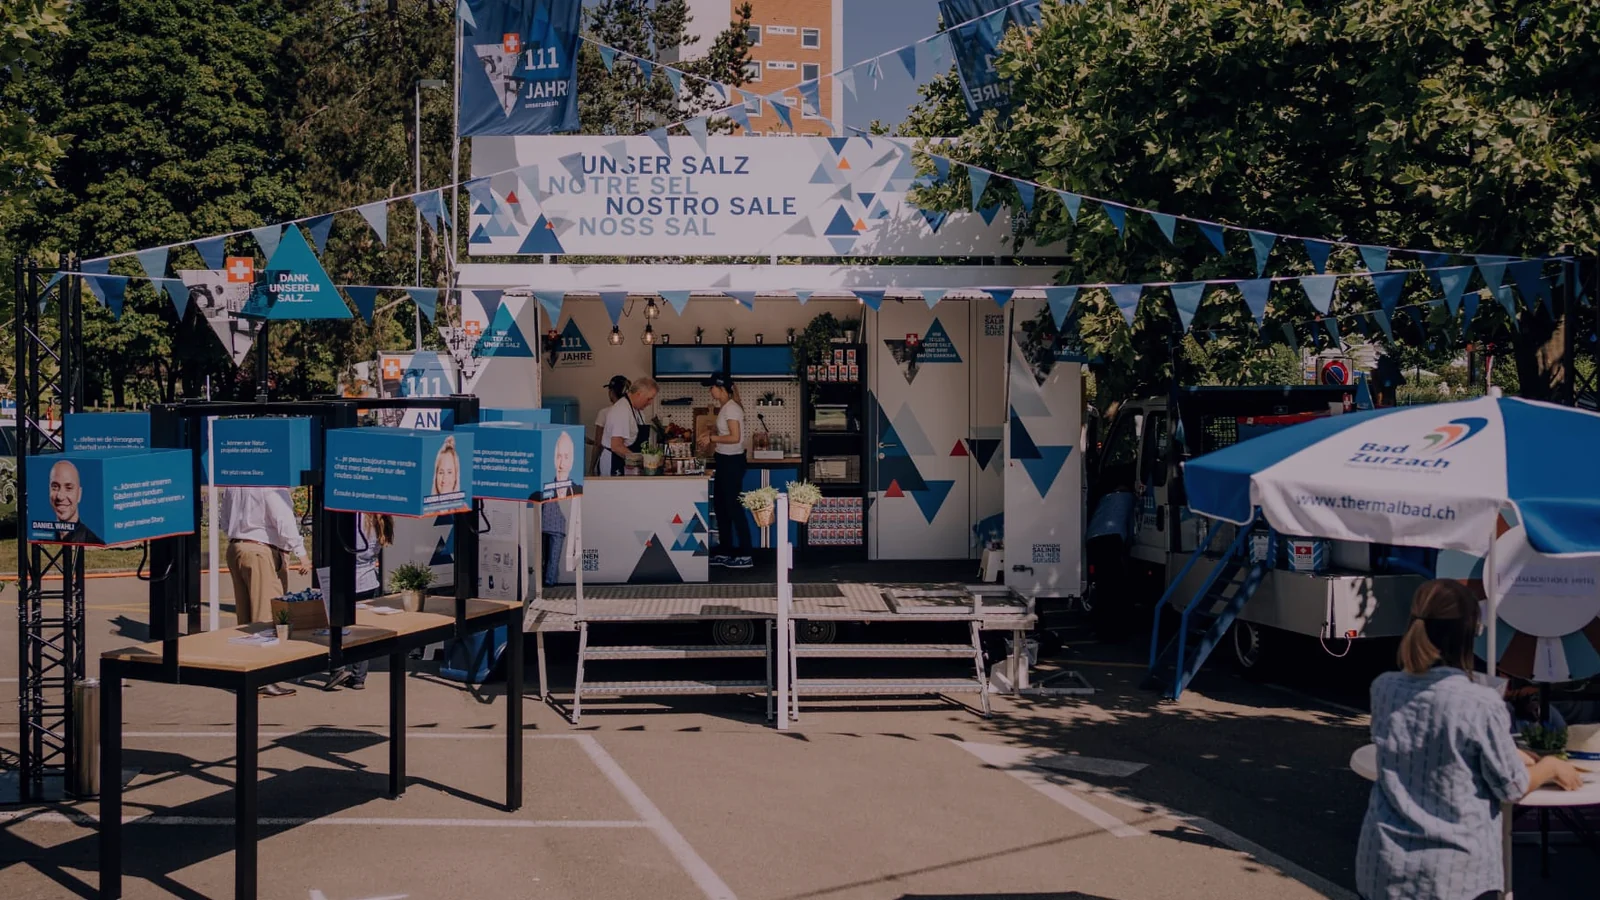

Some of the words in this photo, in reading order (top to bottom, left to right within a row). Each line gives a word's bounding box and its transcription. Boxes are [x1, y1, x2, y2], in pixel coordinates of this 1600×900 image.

[525, 47, 559, 70] 111
[581, 155, 671, 175] UNSER
[682, 155, 750, 175] SALZ
[549, 176, 639, 195] NOTRE
[651, 176, 699, 195] SEL
[606, 196, 719, 216] NOSTRO
[730, 196, 797, 216] SALE
[579, 216, 656, 236] NOSS
[665, 217, 716, 236] SAL
[279, 273, 309, 283] DANK
[269, 283, 320, 293] UNSEREM
[561, 336, 582, 348] 111
[561, 352, 593, 361] JAHRE
[407, 377, 441, 398] 111
[1359, 442, 1410, 453] Bad
[1349, 453, 1451, 468] Zurzach
[1295, 495, 1456, 521] www.thermalbad.ch
[33, 521, 55, 530] DANIEL
[55, 523, 75, 531] WAHLI
